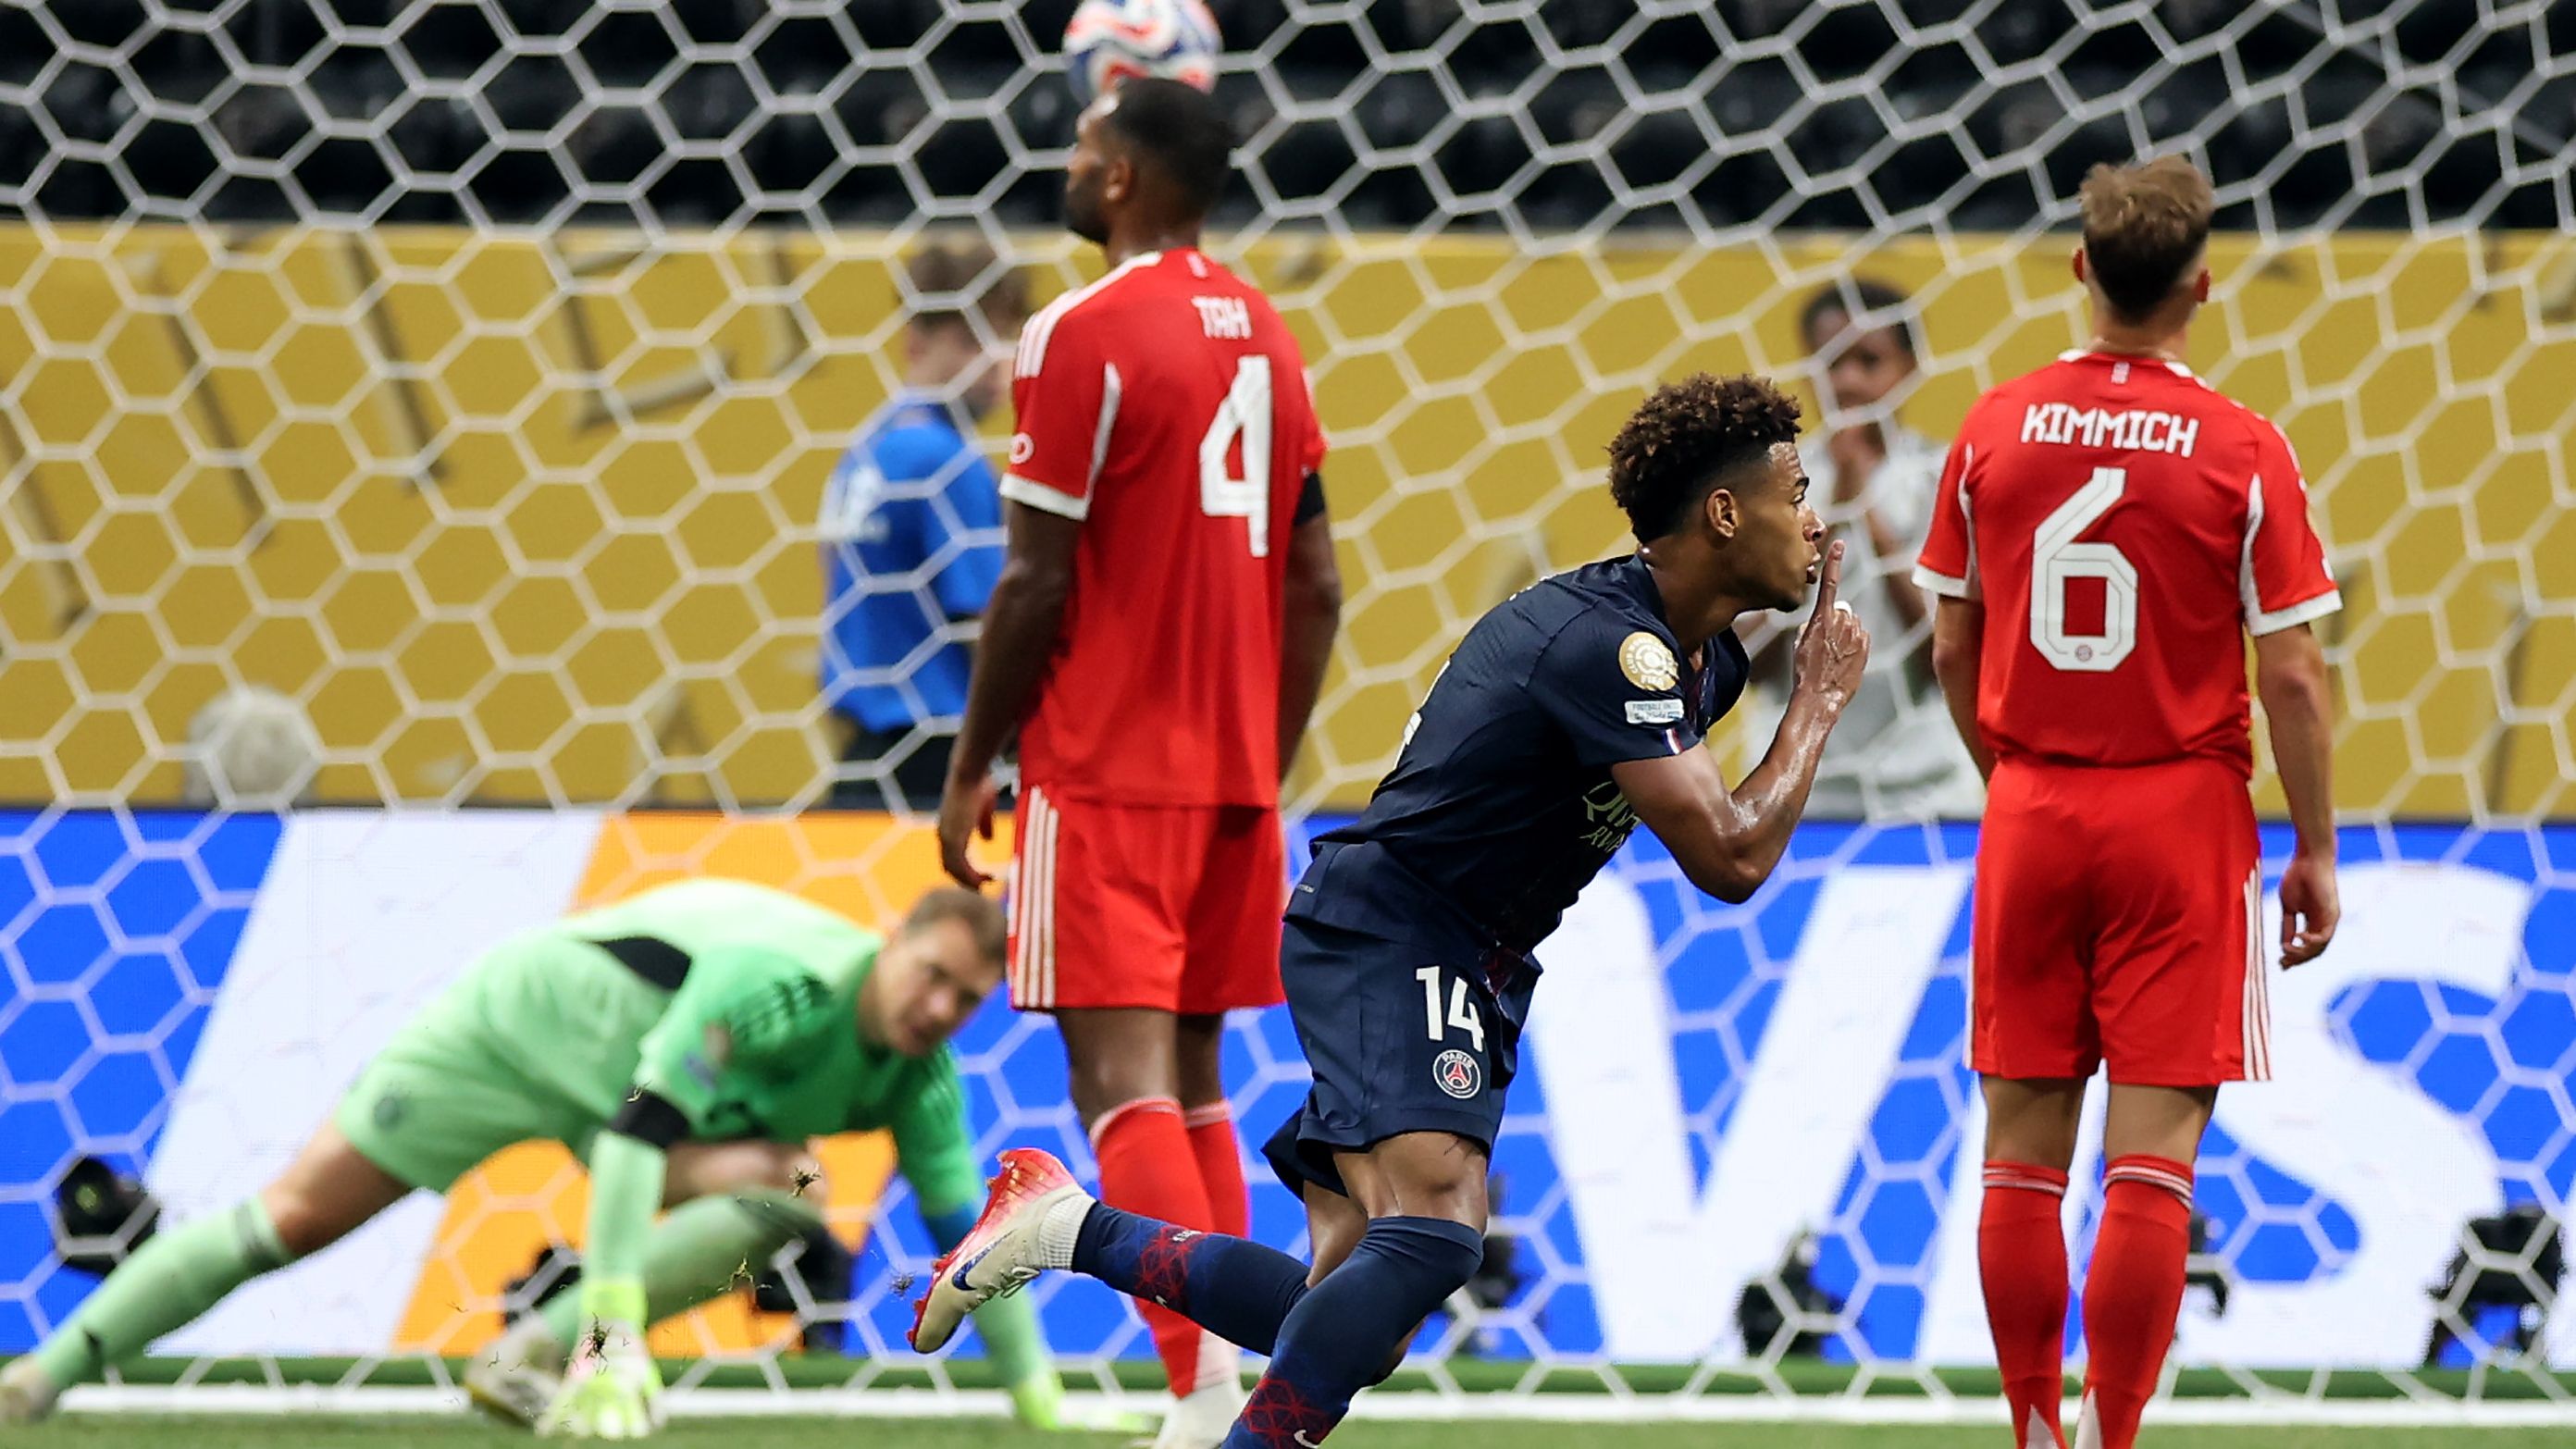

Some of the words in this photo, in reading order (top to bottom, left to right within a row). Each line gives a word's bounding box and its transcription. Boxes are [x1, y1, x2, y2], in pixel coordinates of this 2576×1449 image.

[1190, 295, 1252, 340] TAH
[1199, 354, 1271, 557] 4
[2021, 402, 2199, 458] KIMMICH
[2029, 466, 2138, 672] 6
[1416, 965, 1485, 1052] 14
[1442, 1052, 1474, 1068] PARIS
[1525, 862, 2576, 1370] VS
